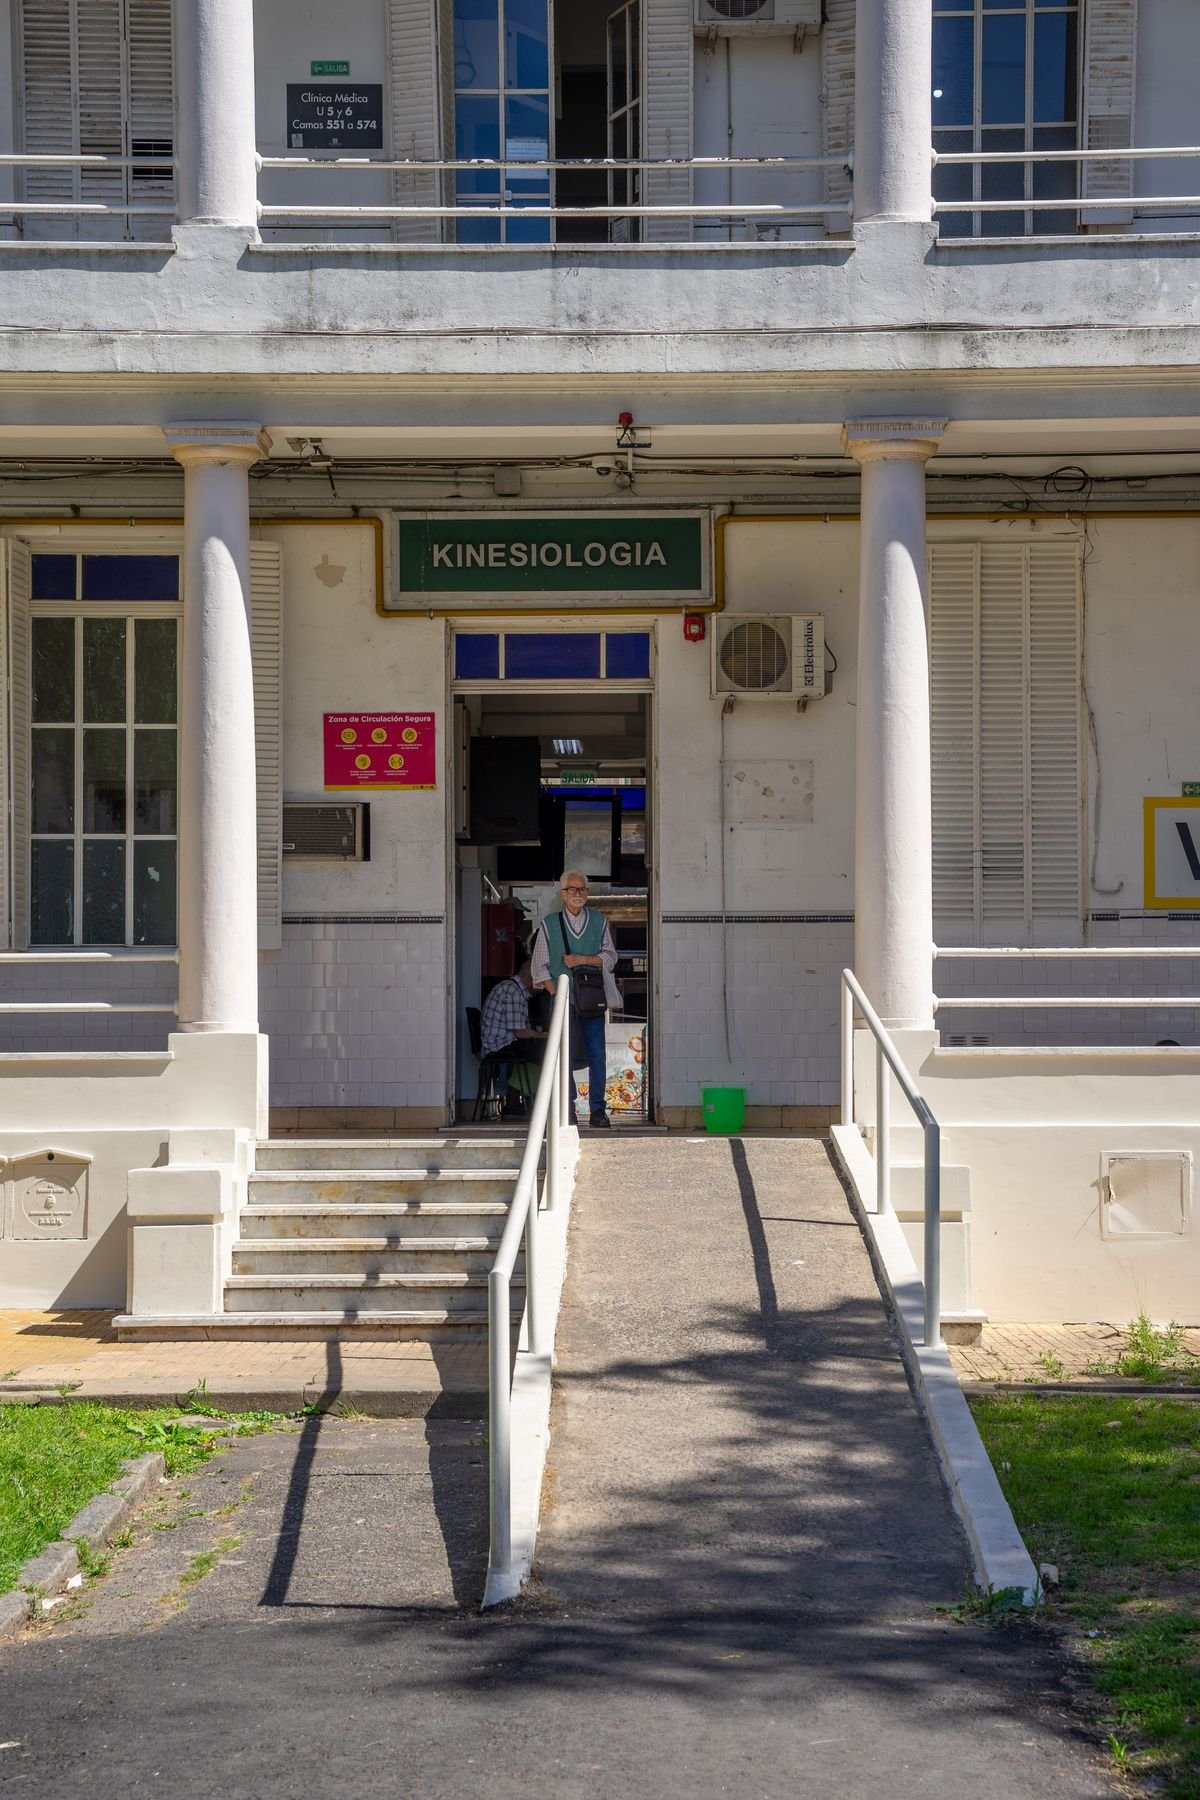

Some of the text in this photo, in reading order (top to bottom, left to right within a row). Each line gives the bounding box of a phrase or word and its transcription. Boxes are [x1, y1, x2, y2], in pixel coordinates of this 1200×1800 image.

[324, 64, 348, 73] SALIDA
[301, 92, 368, 103] Clínica Médica
[316, 106, 353, 119] U 5 y 6
[292, 119, 324, 129] Camas
[326, 120, 345, 129] 551
[356, 120, 377, 130] 574
[433, 542, 667, 567] KINESIOLOGIA
[804, 621, 813, 673] Electrolux
[349, 715, 359, 723] de
[361, 715, 404, 723] Circulación
[405, 715, 431, 723] Segura
[561, 772, 595, 783] SALIDA
